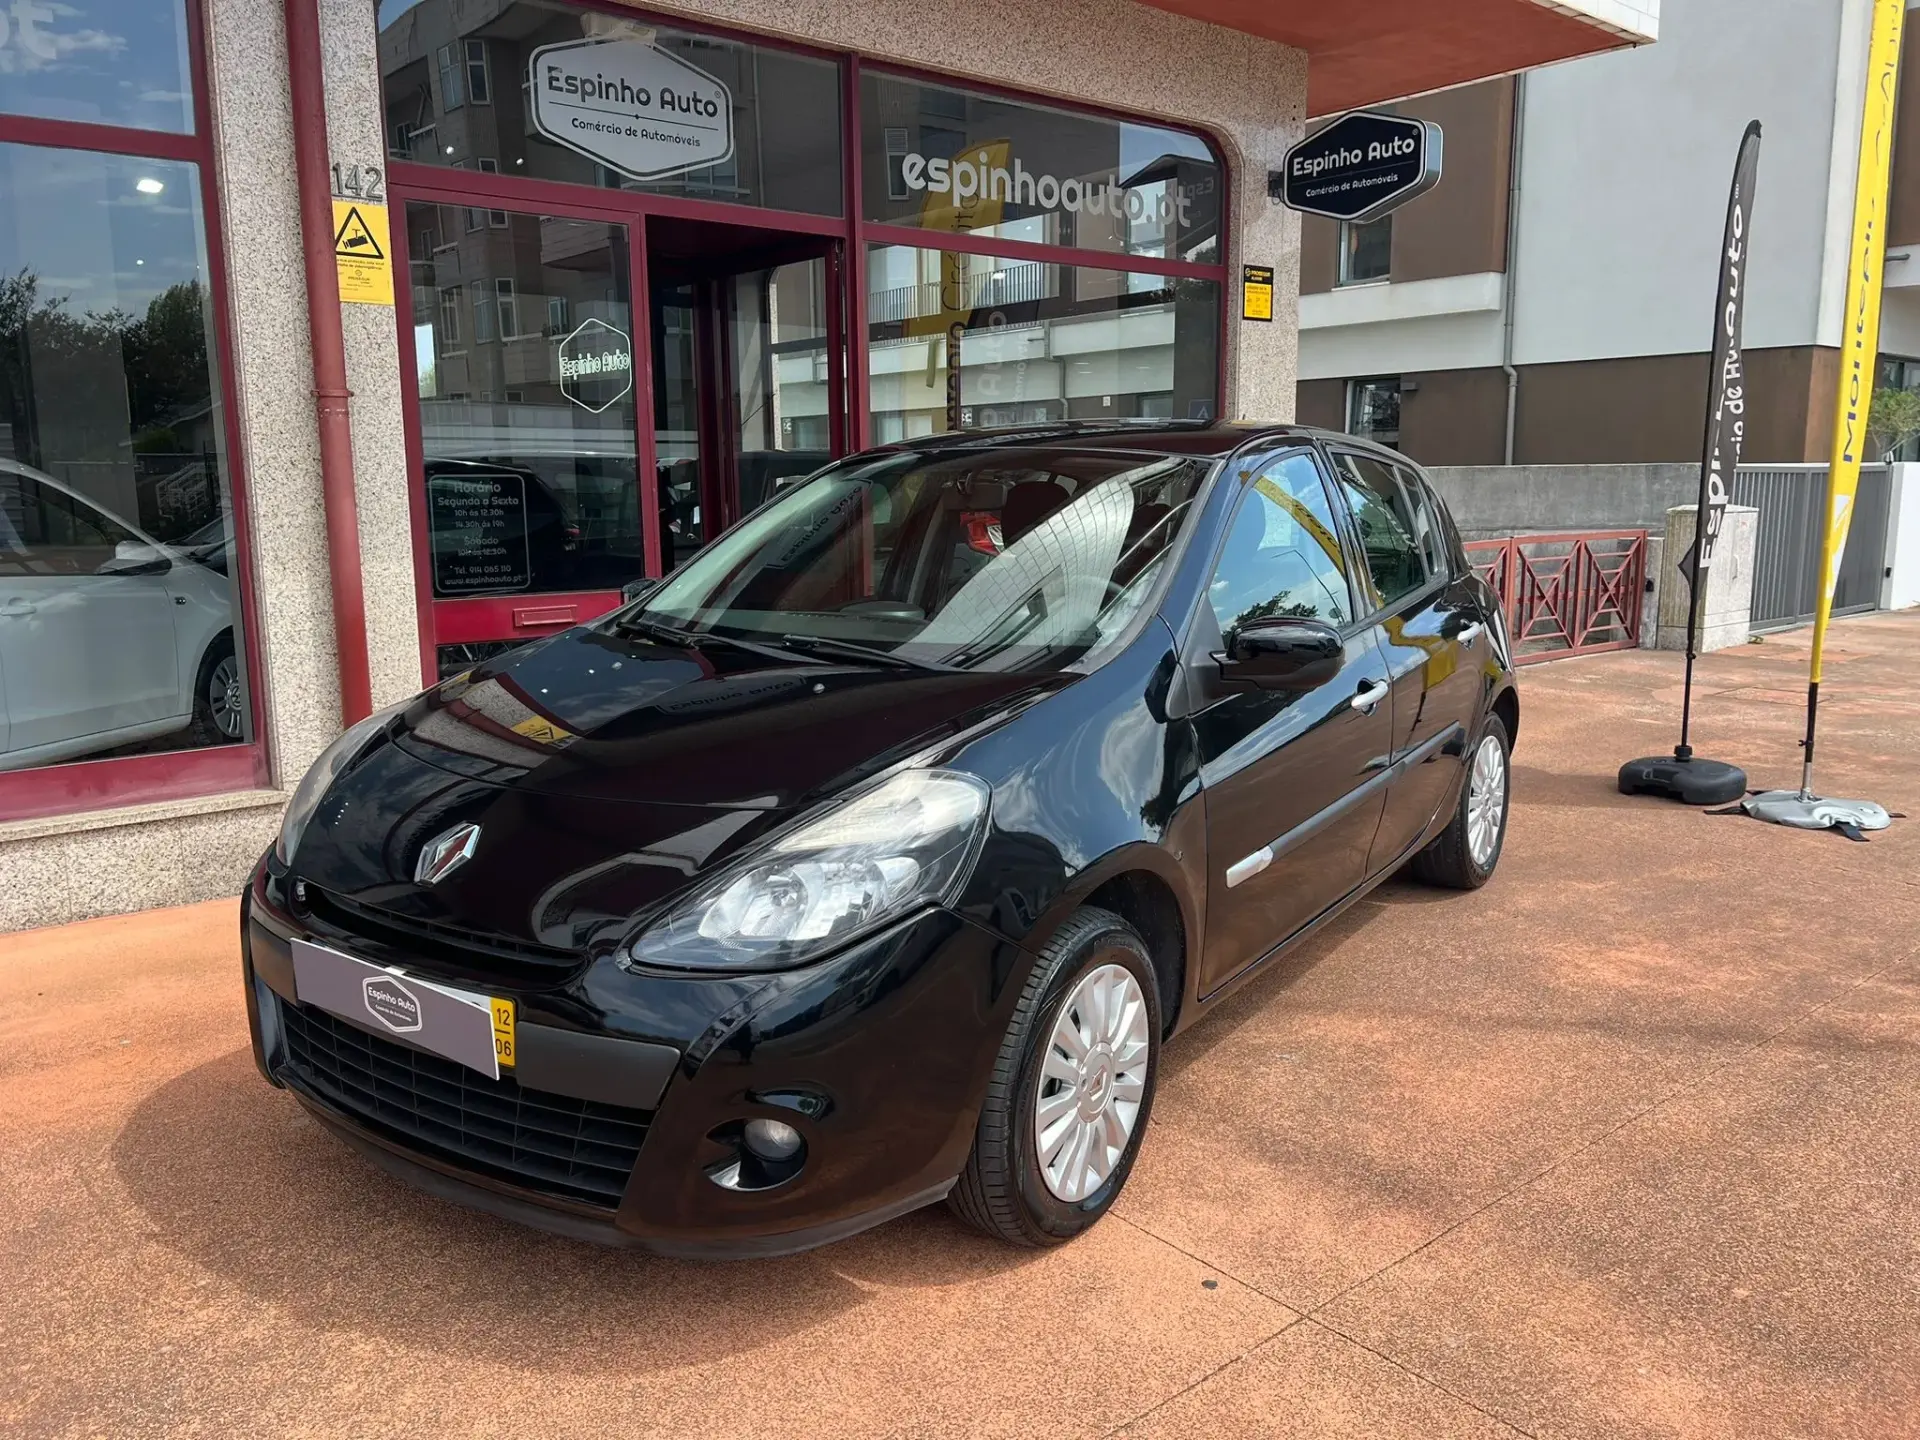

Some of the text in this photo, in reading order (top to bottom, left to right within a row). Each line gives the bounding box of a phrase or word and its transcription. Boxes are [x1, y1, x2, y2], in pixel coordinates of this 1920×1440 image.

[547, 65, 718, 118] Espinho Auto
[571, 117, 701, 147] Comércio de Automóveis
[1293, 135, 1415, 178] Espinho Auto
[332, 163, 383, 199] 142
[902, 151, 1191, 229] espinhoauto.pt
[1305, 172, 1399, 197] Comércio de Automóveis
[560, 348, 630, 381] Espinho Auto
[1724, 385, 1744, 415] de
[454, 480, 502, 493] Horário
[437, 496, 480, 508] Segunda
[491, 496, 519, 506] Sexta
[454, 509, 468, 517] 10h
[480, 508, 505, 516] 12.30h
[454, 567, 468, 575] Tel.
[367, 985, 397, 1006] Espinho
[397, 992, 416, 1013] Auto
[496, 1007, 511, 1027] 12
[495, 1038, 512, 1057] 06
